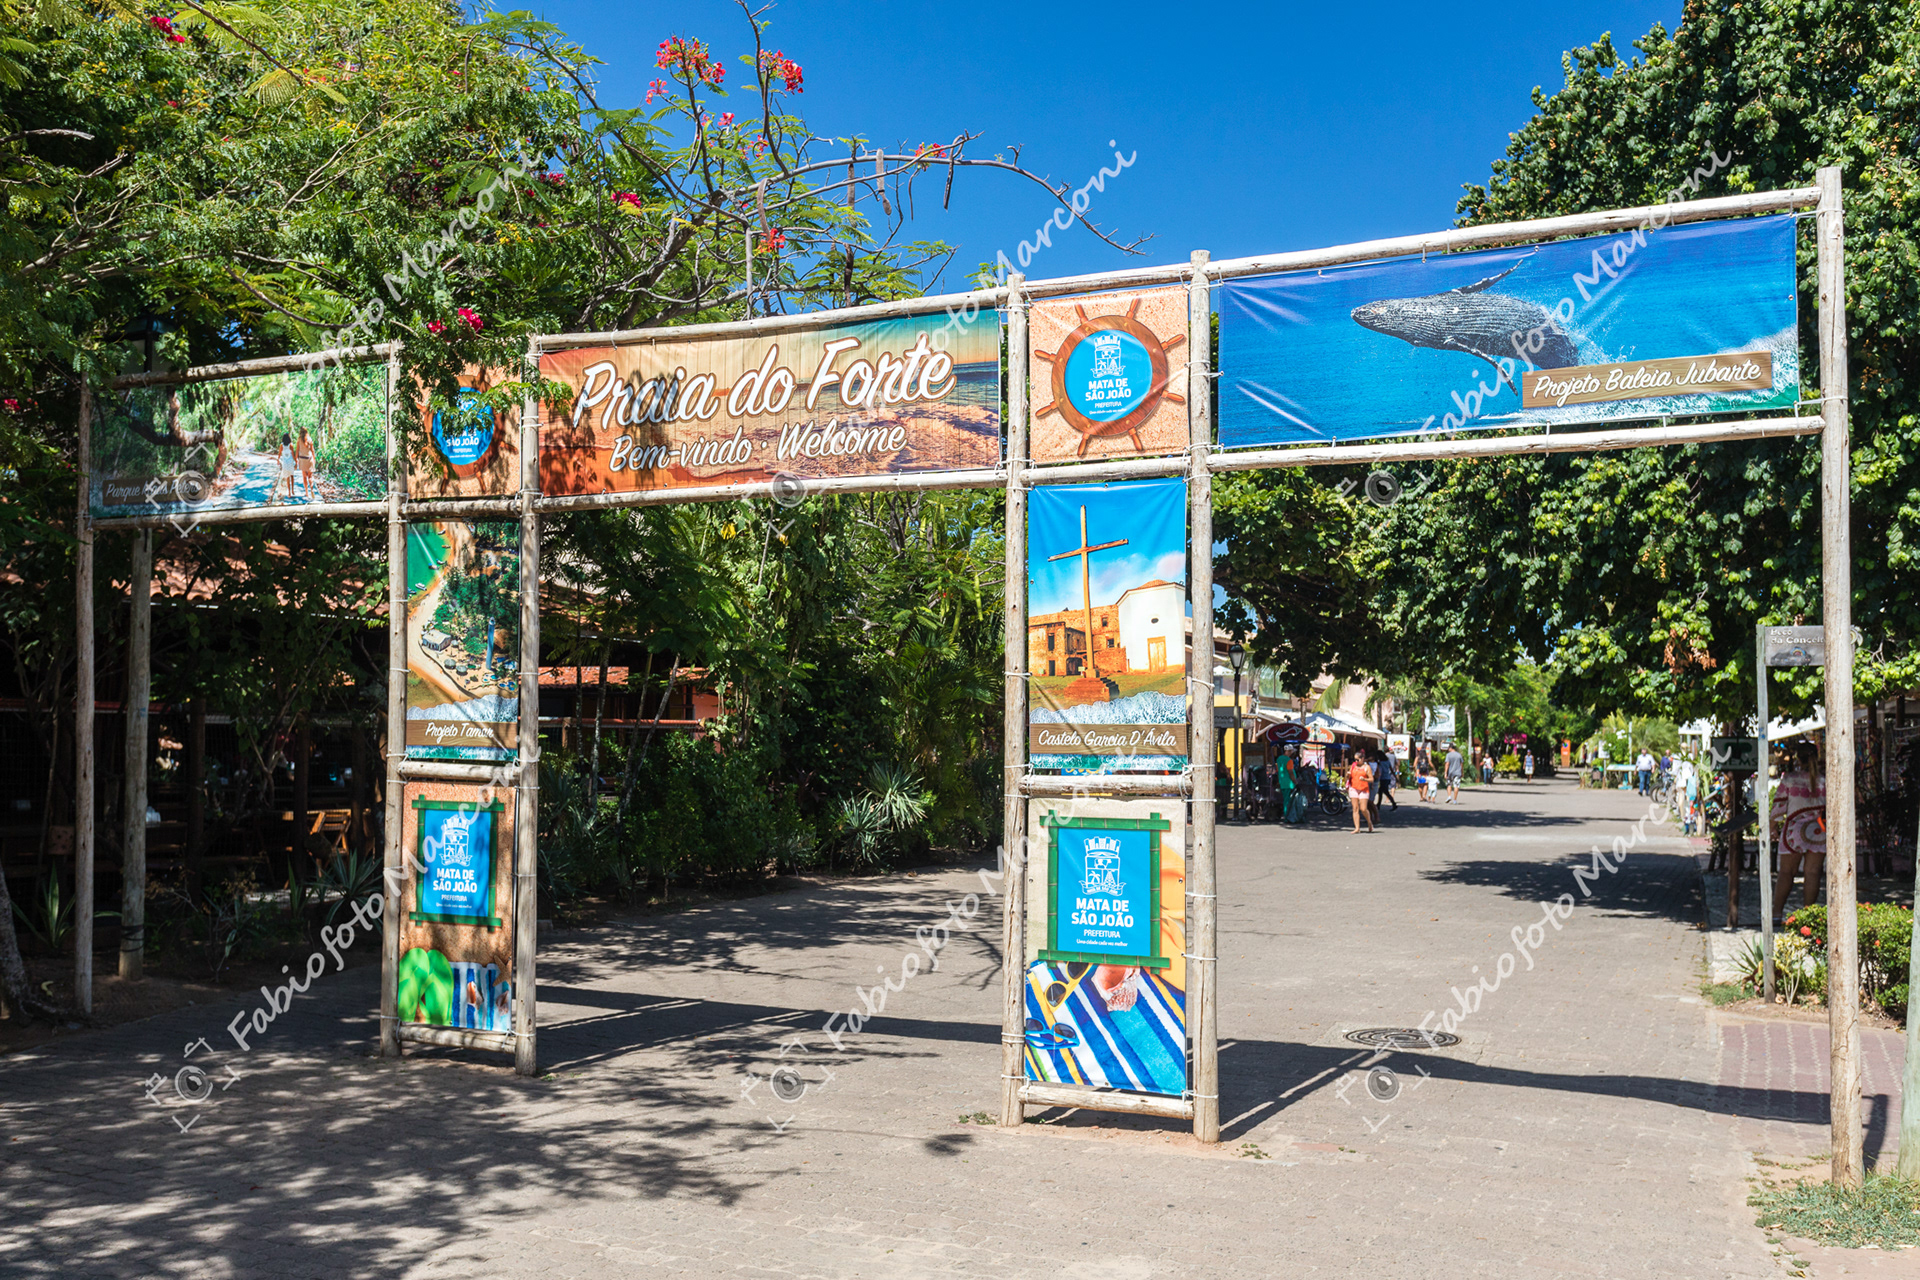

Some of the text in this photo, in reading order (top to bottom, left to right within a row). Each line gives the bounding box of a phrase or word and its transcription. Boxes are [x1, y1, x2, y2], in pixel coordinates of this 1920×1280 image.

[573, 333, 957, 432] Praia do Forte
[1088, 378, 1128, 390] MATA DE
[1531, 358, 1762, 408] Projeto Baleia Jubarte
[1085, 387, 1132, 401] SÃO JOÃO
[609, 419, 907, 472] Bem-vindo Welcome
[106, 483, 140, 502] Parque
[1786, 636, 1824, 644] Concei
[425, 722, 494, 744] Projeto Tamar
[1038, 730, 1081, 746] Castelo
[1084, 731, 1127, 747] Garcia
[437, 868, 475, 880] MATA DE
[433, 878, 477, 893] SÃO JOÃO
[1076, 898, 1129, 912] MATA DE
[1071, 910, 1134, 928] SÃO JOÃO
[1083, 929, 1121, 938] PREFEITURA
